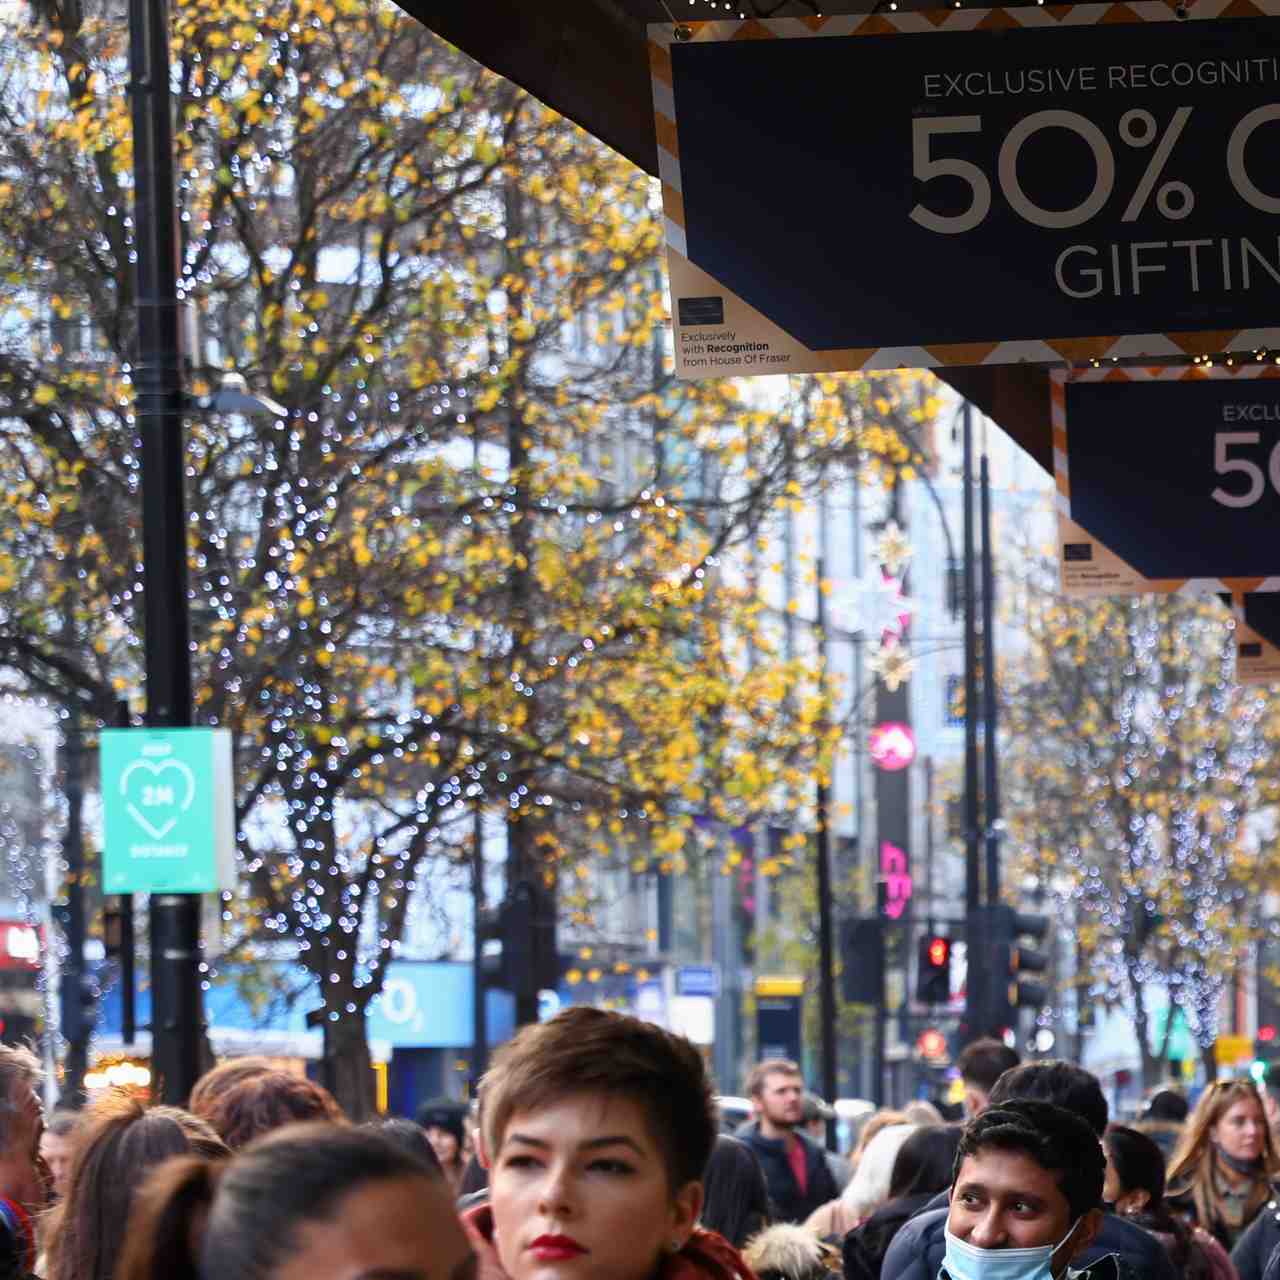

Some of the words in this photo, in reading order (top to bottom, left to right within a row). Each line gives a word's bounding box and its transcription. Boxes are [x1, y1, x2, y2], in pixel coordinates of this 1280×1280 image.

[924, 66, 1097, 98] EXCLUSIVE
[908, 105, 1196, 235] 50%
[680, 331, 737, 343] Exclusively
[682, 344, 706, 355] with
[706, 341, 770, 354] Recognition
[682, 356, 708, 367] from
[709, 354, 742, 366] House
[743, 353, 757, 364] Of
[759, 352, 791, 364] Fraser
